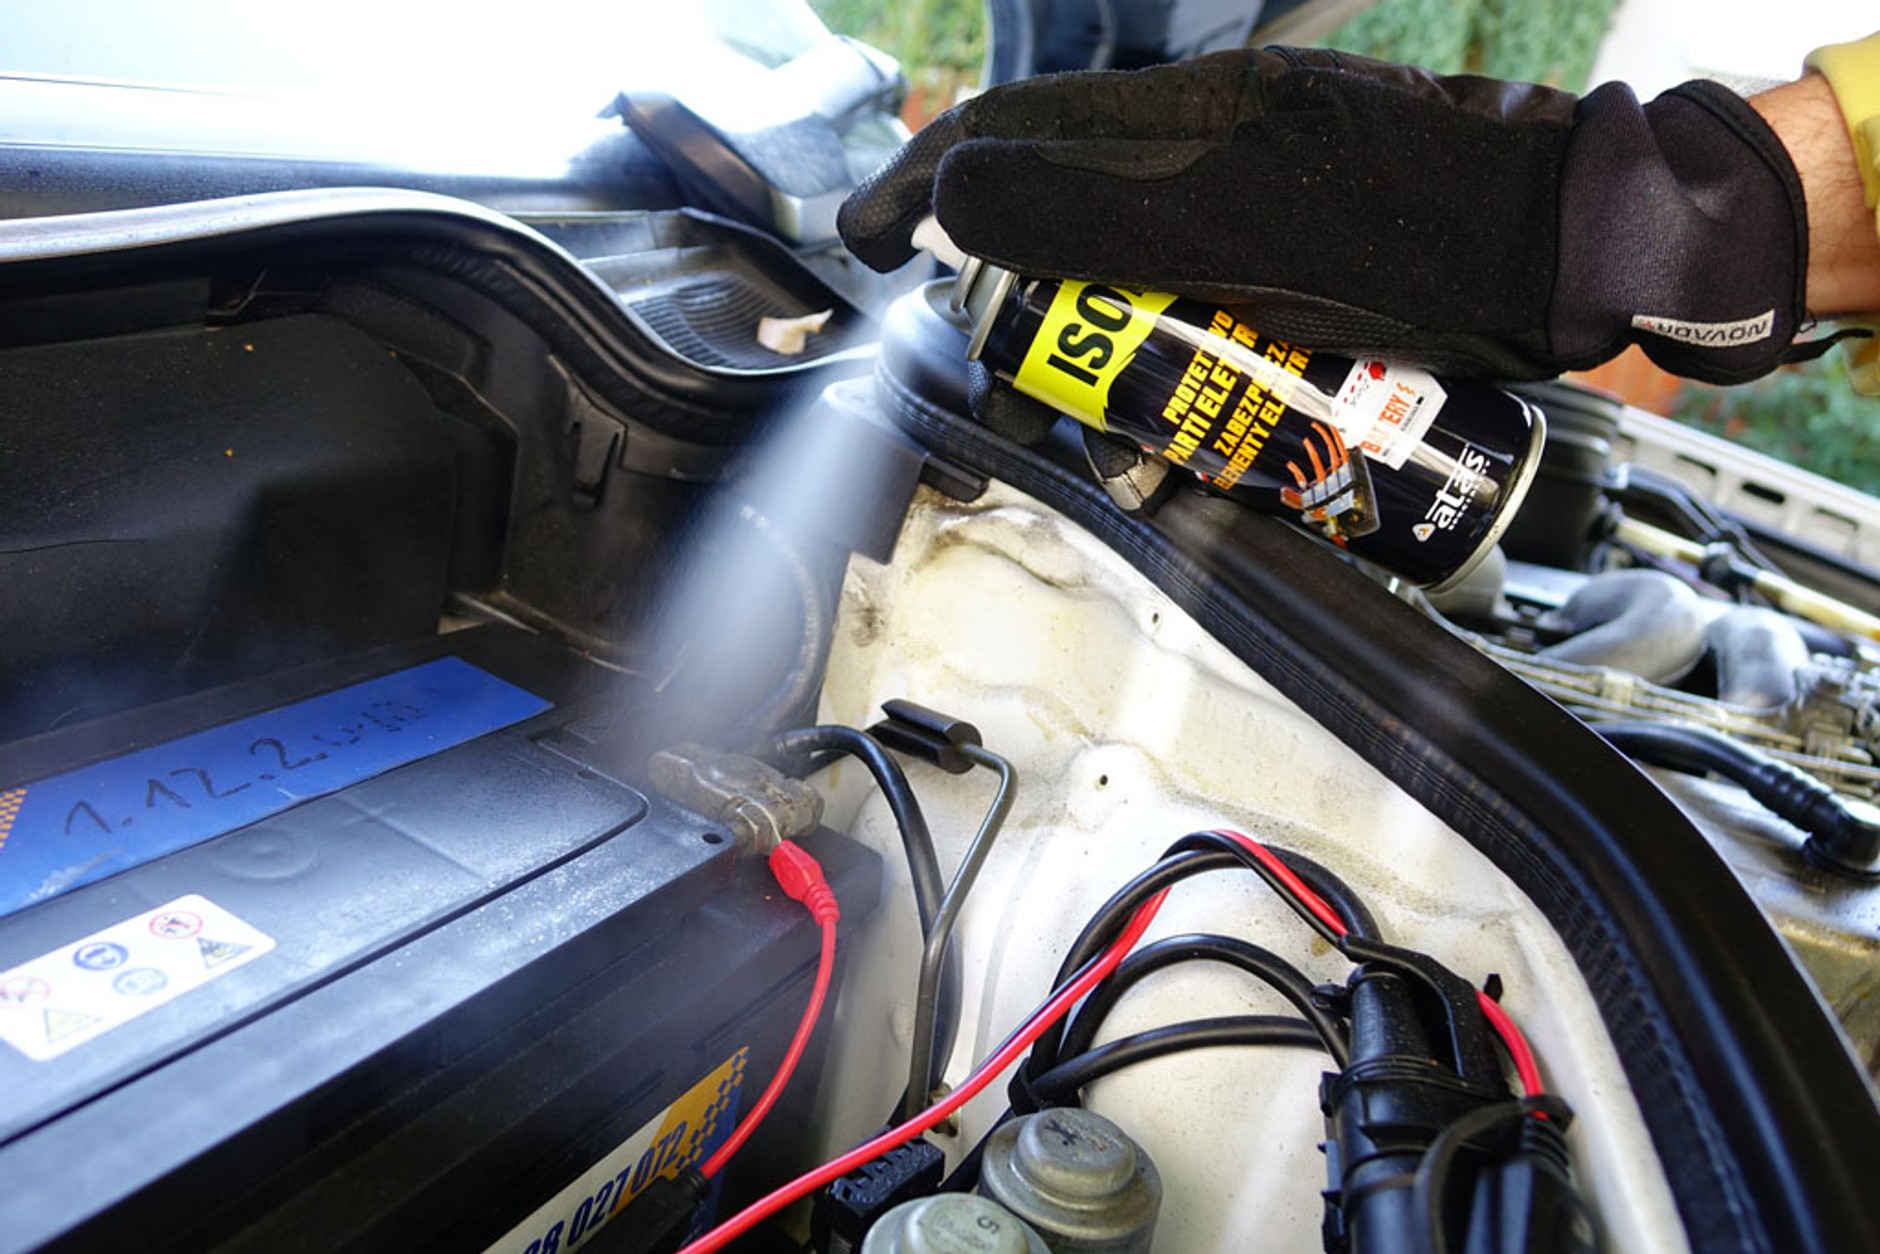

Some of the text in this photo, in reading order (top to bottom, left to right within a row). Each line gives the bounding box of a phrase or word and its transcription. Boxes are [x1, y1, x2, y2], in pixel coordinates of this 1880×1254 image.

[1047, 282, 1142, 387] ISO
[1162, 310, 1234, 425] PROTETVO
[1258, 346, 1313, 427] ELTR
[1163, 323, 1259, 466] PARTI ELETR
[1213, 341, 1290, 456] ZABEZPIZ
[567, 1165, 632, 1247] 027
[630, 1121, 687, 1194] 072
